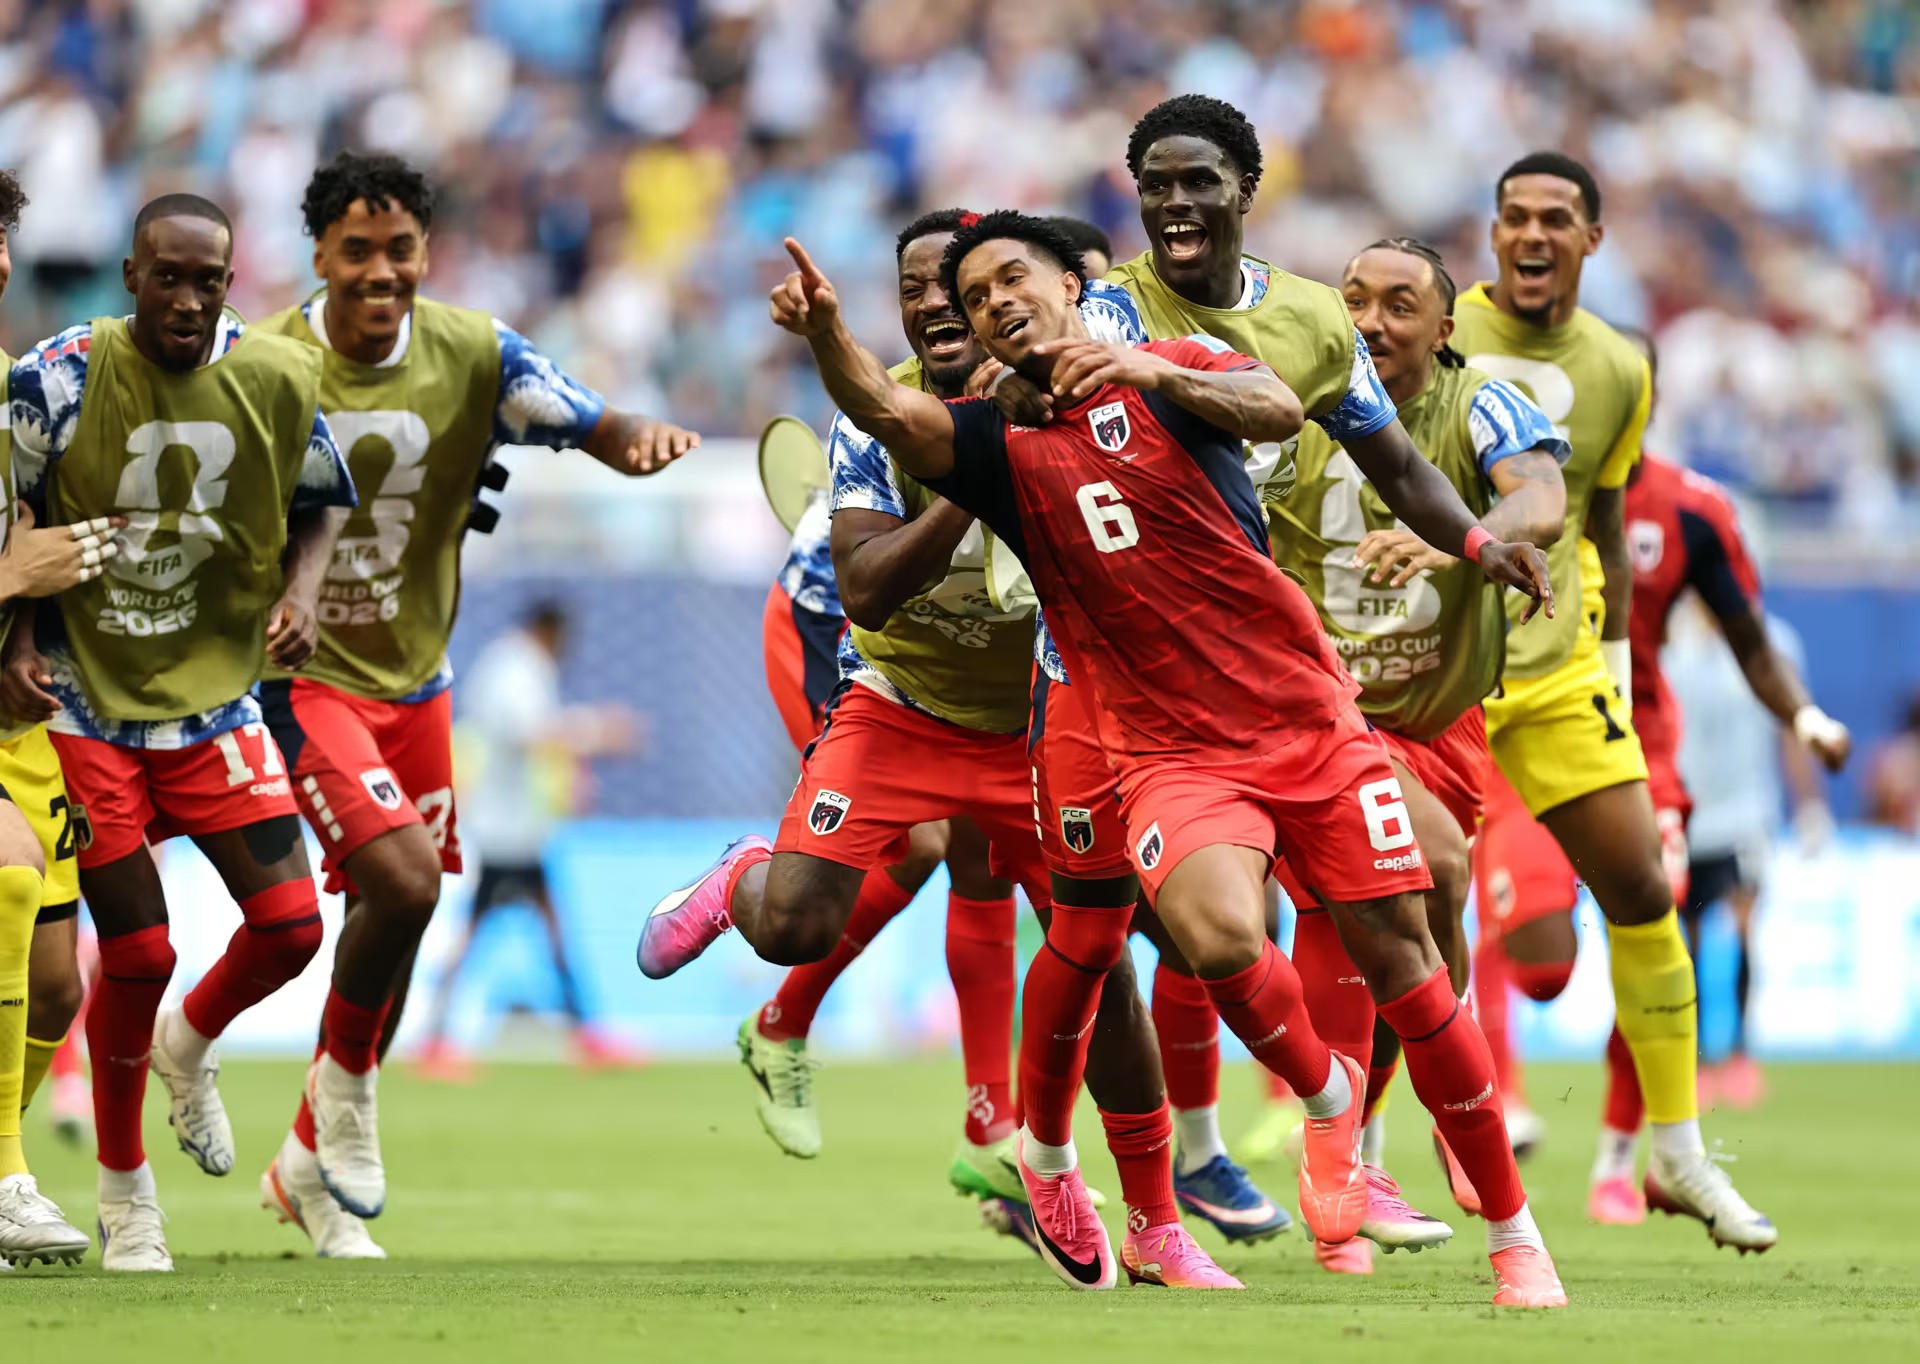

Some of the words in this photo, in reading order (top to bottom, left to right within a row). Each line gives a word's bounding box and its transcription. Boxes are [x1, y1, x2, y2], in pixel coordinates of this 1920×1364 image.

[1092, 405, 1121, 420] FCF
[1076, 480, 1140, 553] 6
[137, 552, 182, 577] FIFA
[105, 588, 170, 610] WORLD
[316, 594, 399, 626] 026
[1358, 597, 1409, 619] FIFA
[97, 600, 198, 637] 2026
[1401, 634, 1442, 656] CUP
[1340, 650, 1441, 684] 026
[213, 722, 284, 787] 17
[820, 791, 849, 804] FCF
[1062, 809, 1088, 818] FCF
[1358, 777, 1414, 852] 6
